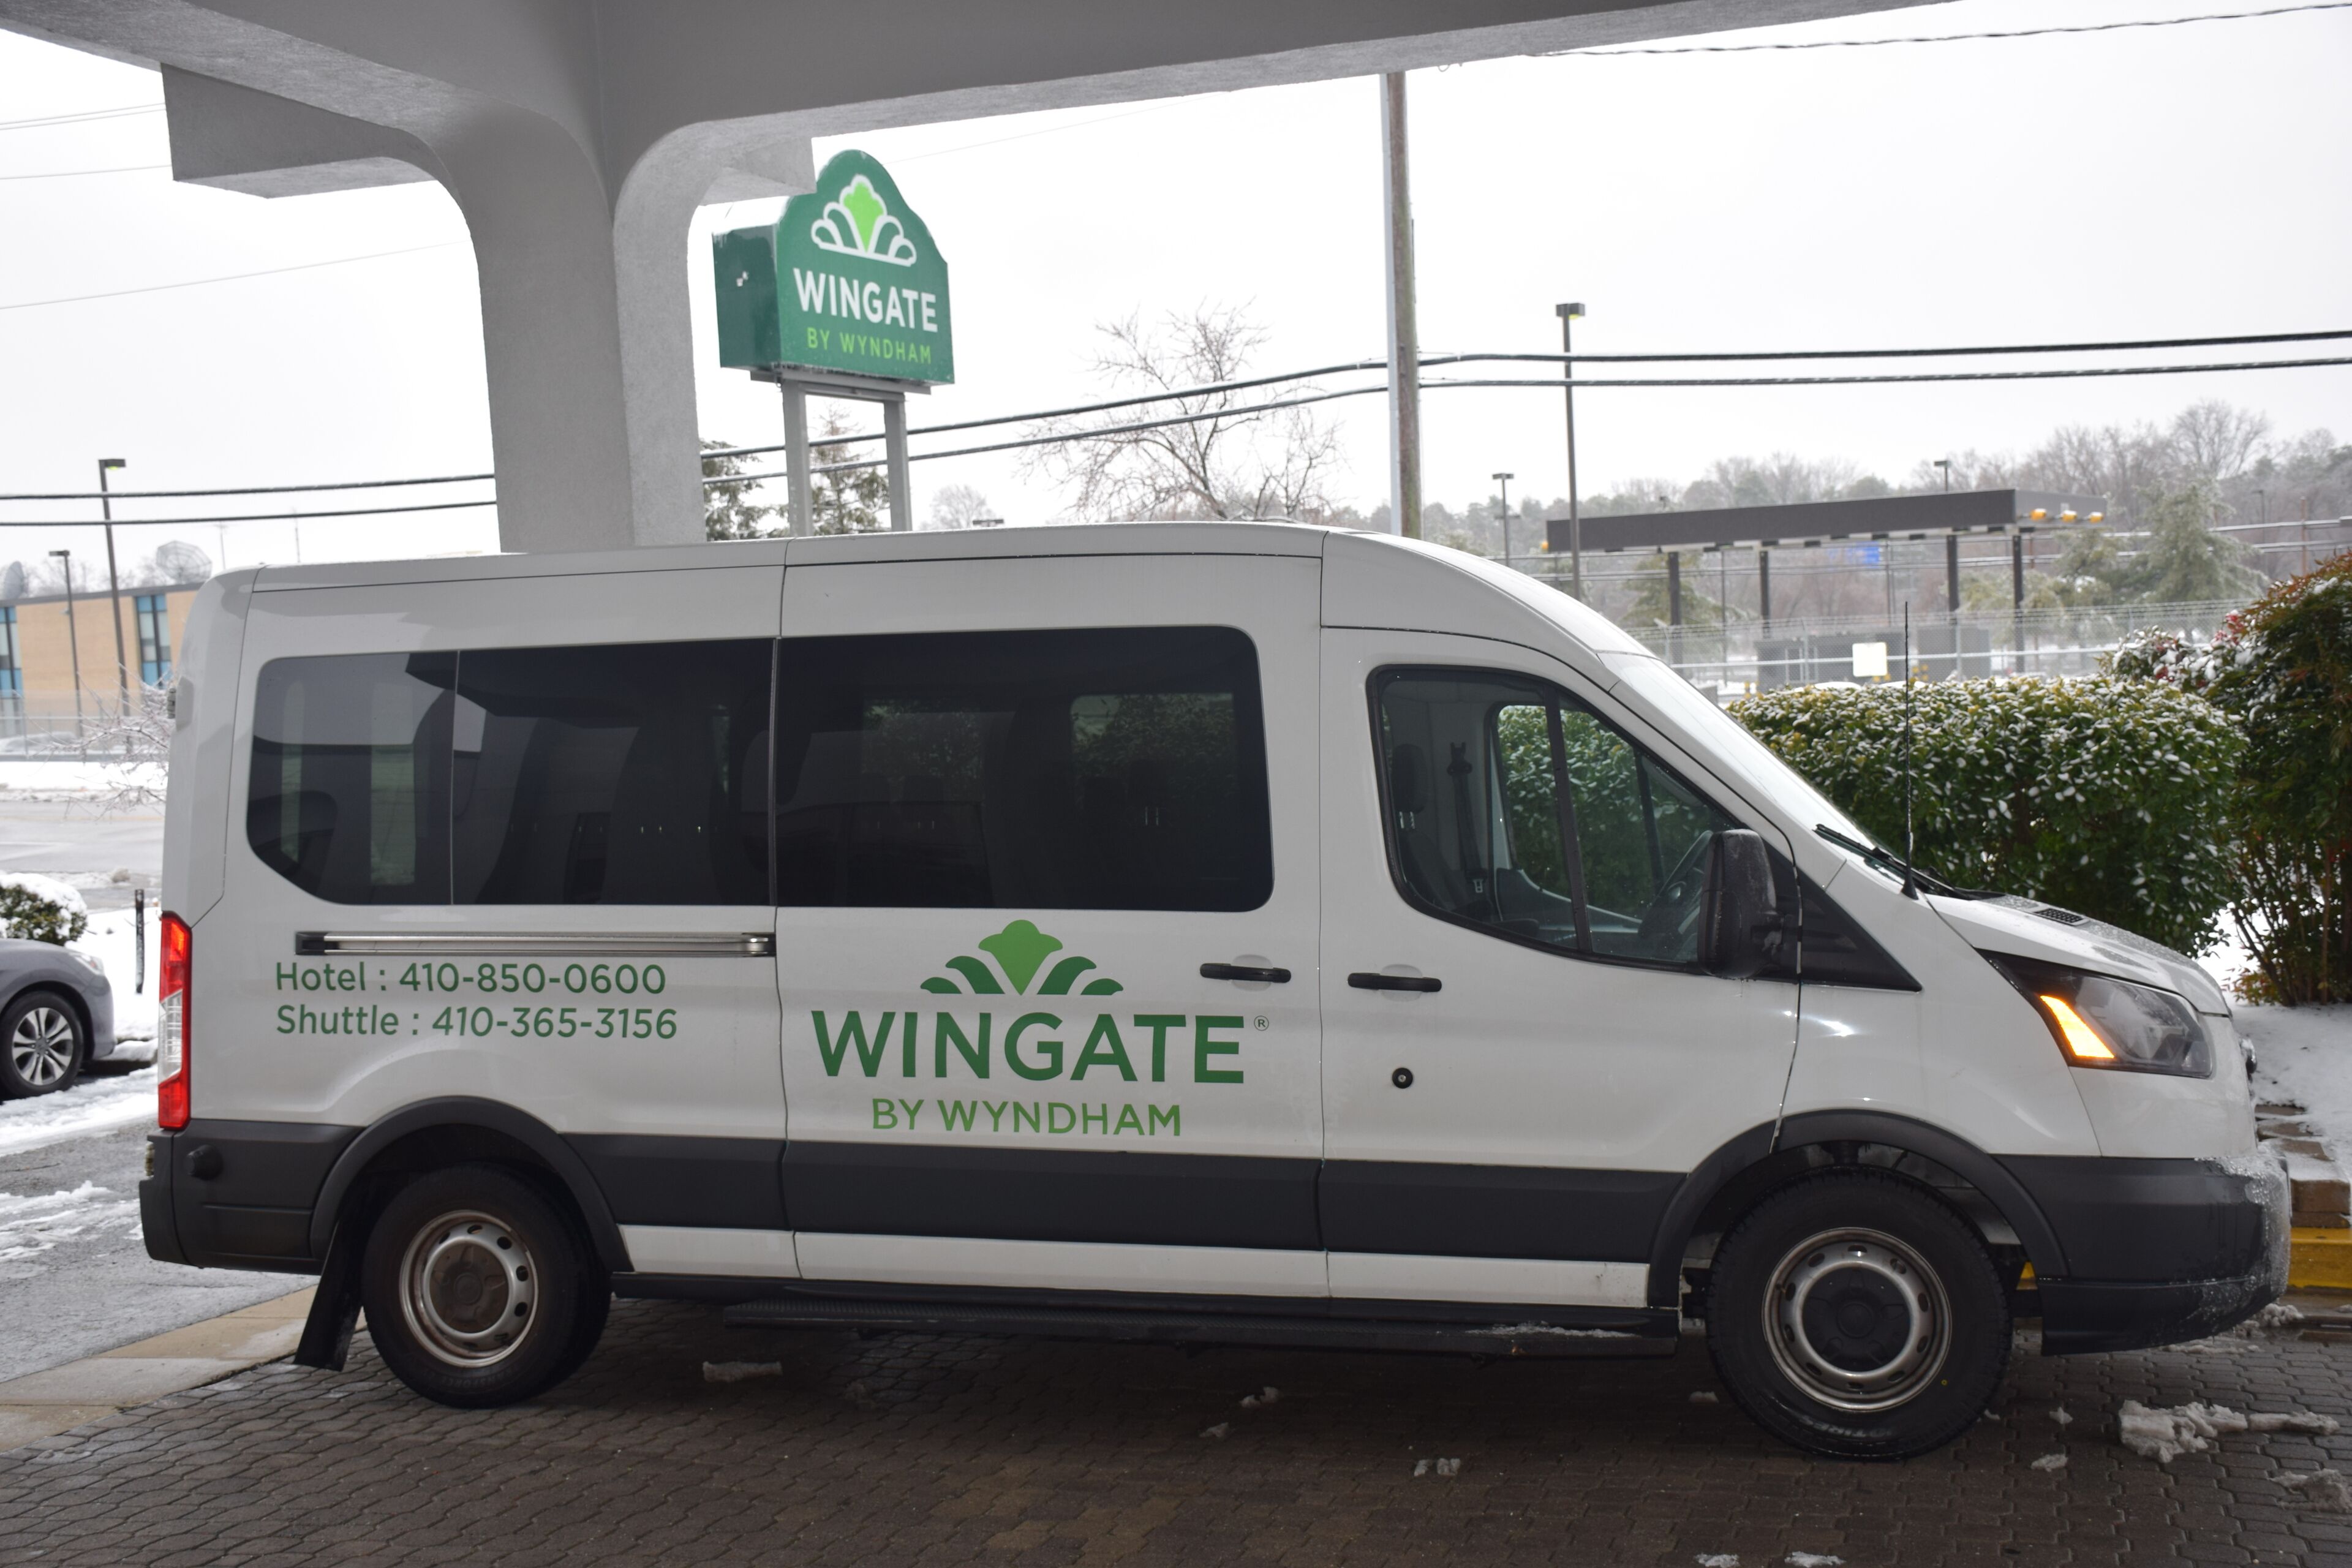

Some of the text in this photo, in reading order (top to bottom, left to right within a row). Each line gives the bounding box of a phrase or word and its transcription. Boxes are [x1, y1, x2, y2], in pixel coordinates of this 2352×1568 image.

[793, 268, 938, 333] WINGATE
[806, 326, 932, 364] BY WYNDHAM
[276, 962, 366, 991] Hotel
[399, 963, 666, 994] 410-850-0600
[276, 1005, 399, 1036] Shuttle
[432, 1006, 677, 1039] 410-365-3156
[812, 1011, 1245, 1084] WINGATE
[872, 1098, 1181, 1136] BY WYNDHAM
